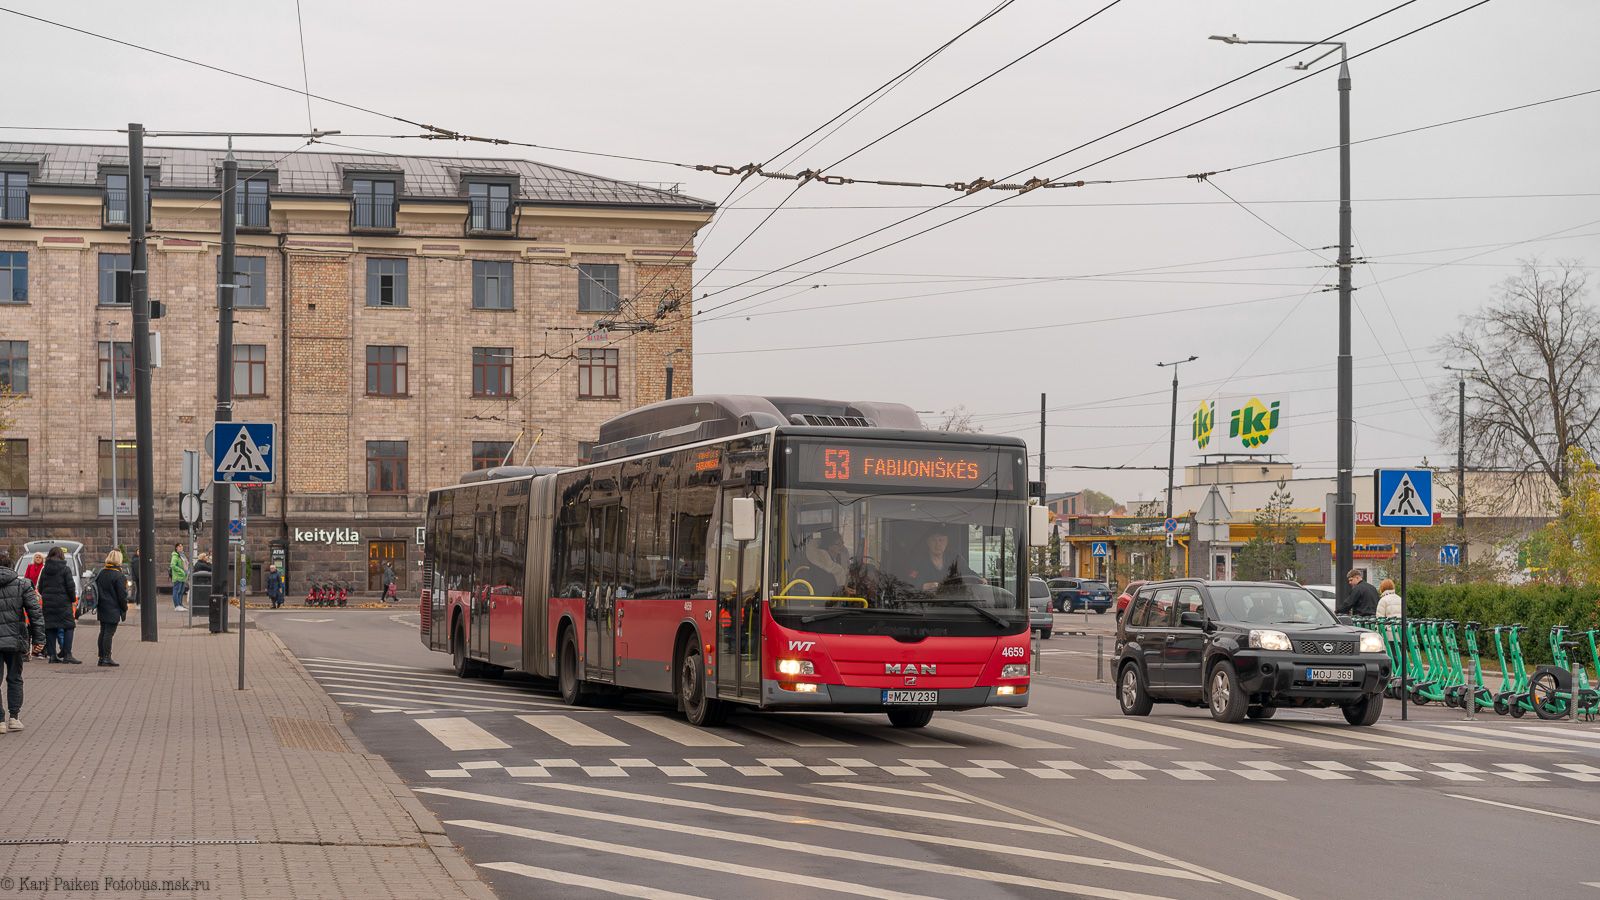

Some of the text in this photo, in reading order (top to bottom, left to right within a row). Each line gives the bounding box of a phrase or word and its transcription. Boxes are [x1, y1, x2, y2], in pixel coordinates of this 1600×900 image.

[1192, 401, 1215, 441] iki
[1229, 401, 1280, 438] iki
[825, 449, 979, 480] 53 FABIJONIŠKĖS
[295, 528, 359, 544] keitykla
[1002, 647, 1024, 658] 4659
[885, 663, 937, 675] MAN
[1312, 670, 1352, 679] MOJ 369
